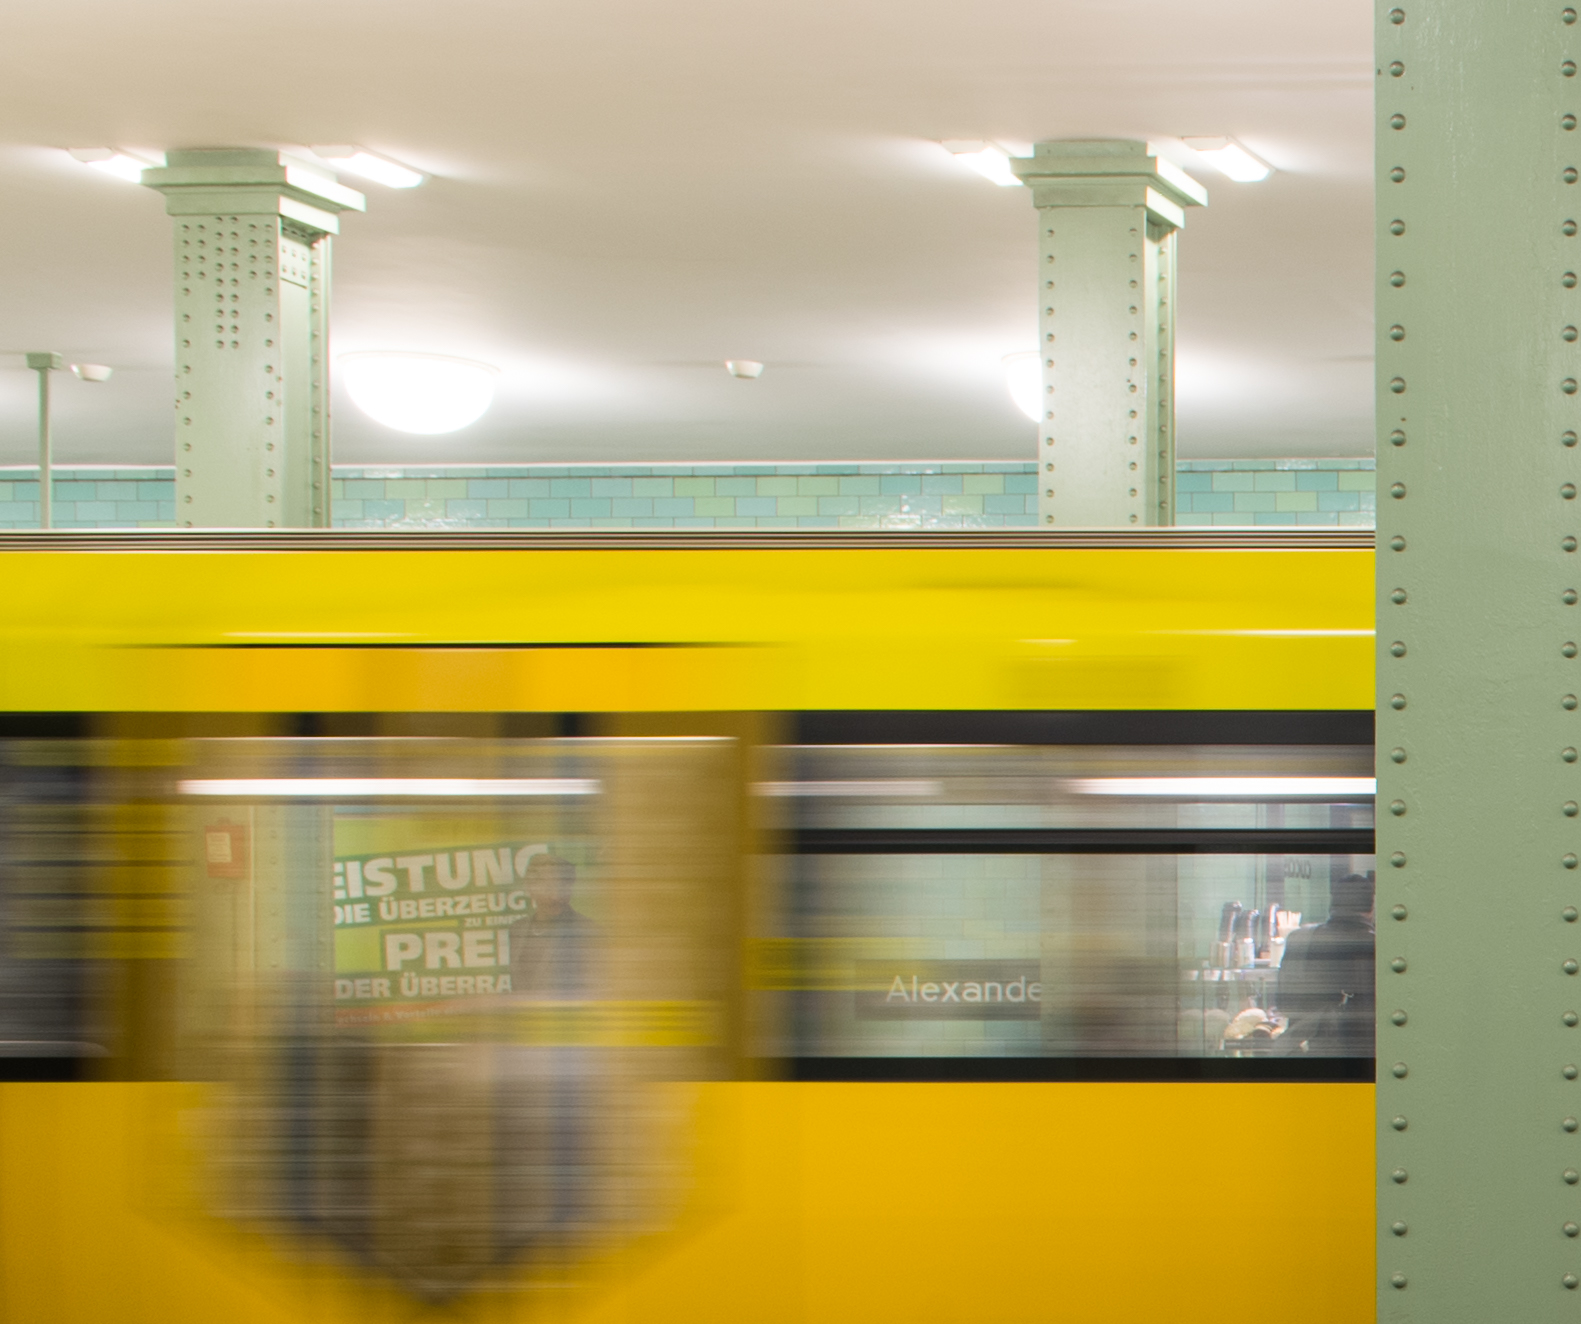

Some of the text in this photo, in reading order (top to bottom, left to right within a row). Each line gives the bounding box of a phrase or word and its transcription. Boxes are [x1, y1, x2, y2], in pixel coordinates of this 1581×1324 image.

[380, 890, 537, 921] ÜBERZEUG
[464, 918, 482, 927] ZU
[385, 929, 510, 971] PREI
[335, 971, 512, 999] DER ÜBERRA
[886, 975, 1042, 1003] Alexande
